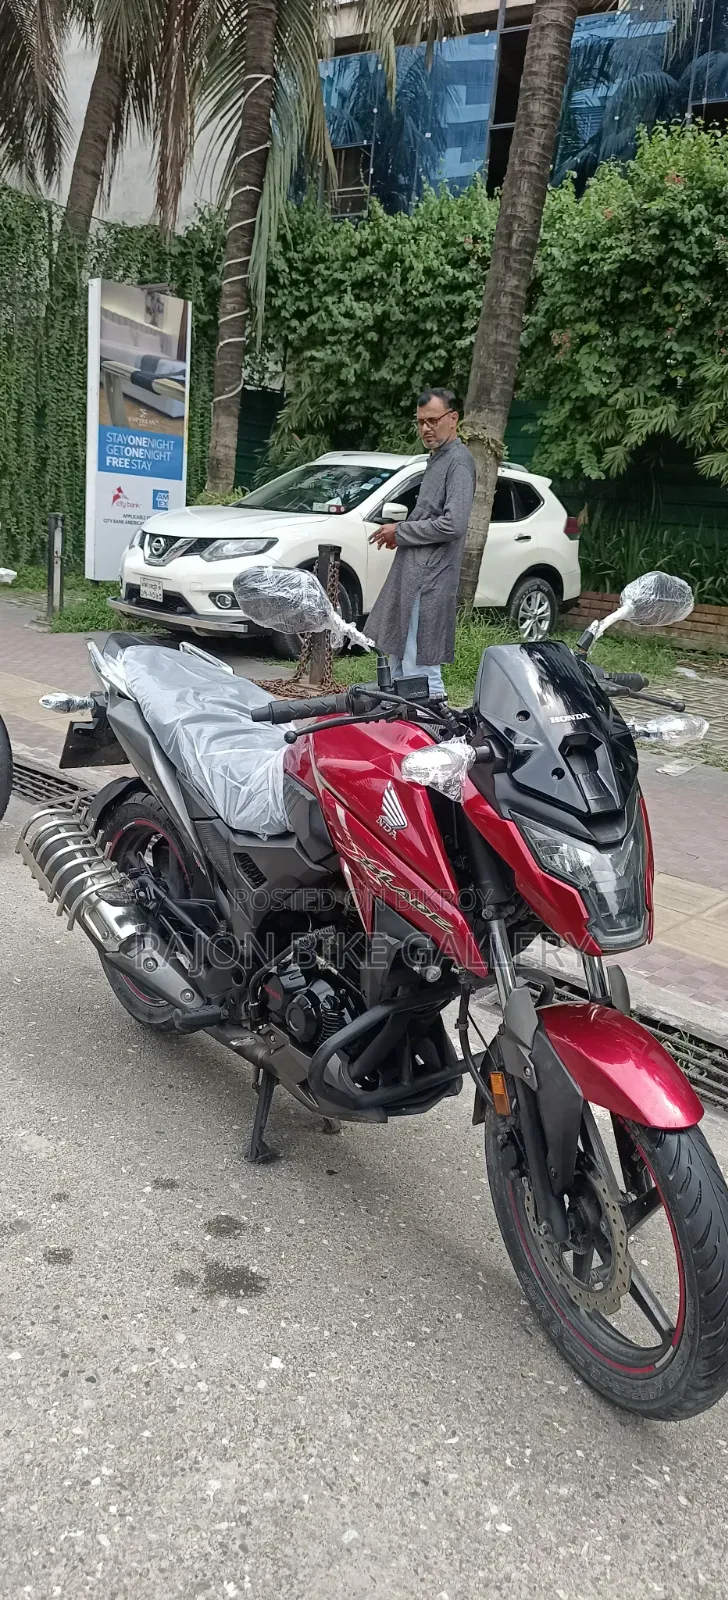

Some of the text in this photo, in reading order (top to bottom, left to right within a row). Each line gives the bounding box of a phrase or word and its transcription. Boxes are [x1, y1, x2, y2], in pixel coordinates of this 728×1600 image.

[106, 432, 175, 451] STAYONENIGHT
[106, 445, 172, 462] GETONENIGHT
[106, 456, 152, 471] FREE STAY
[549, 712, 591, 724] HONDA
